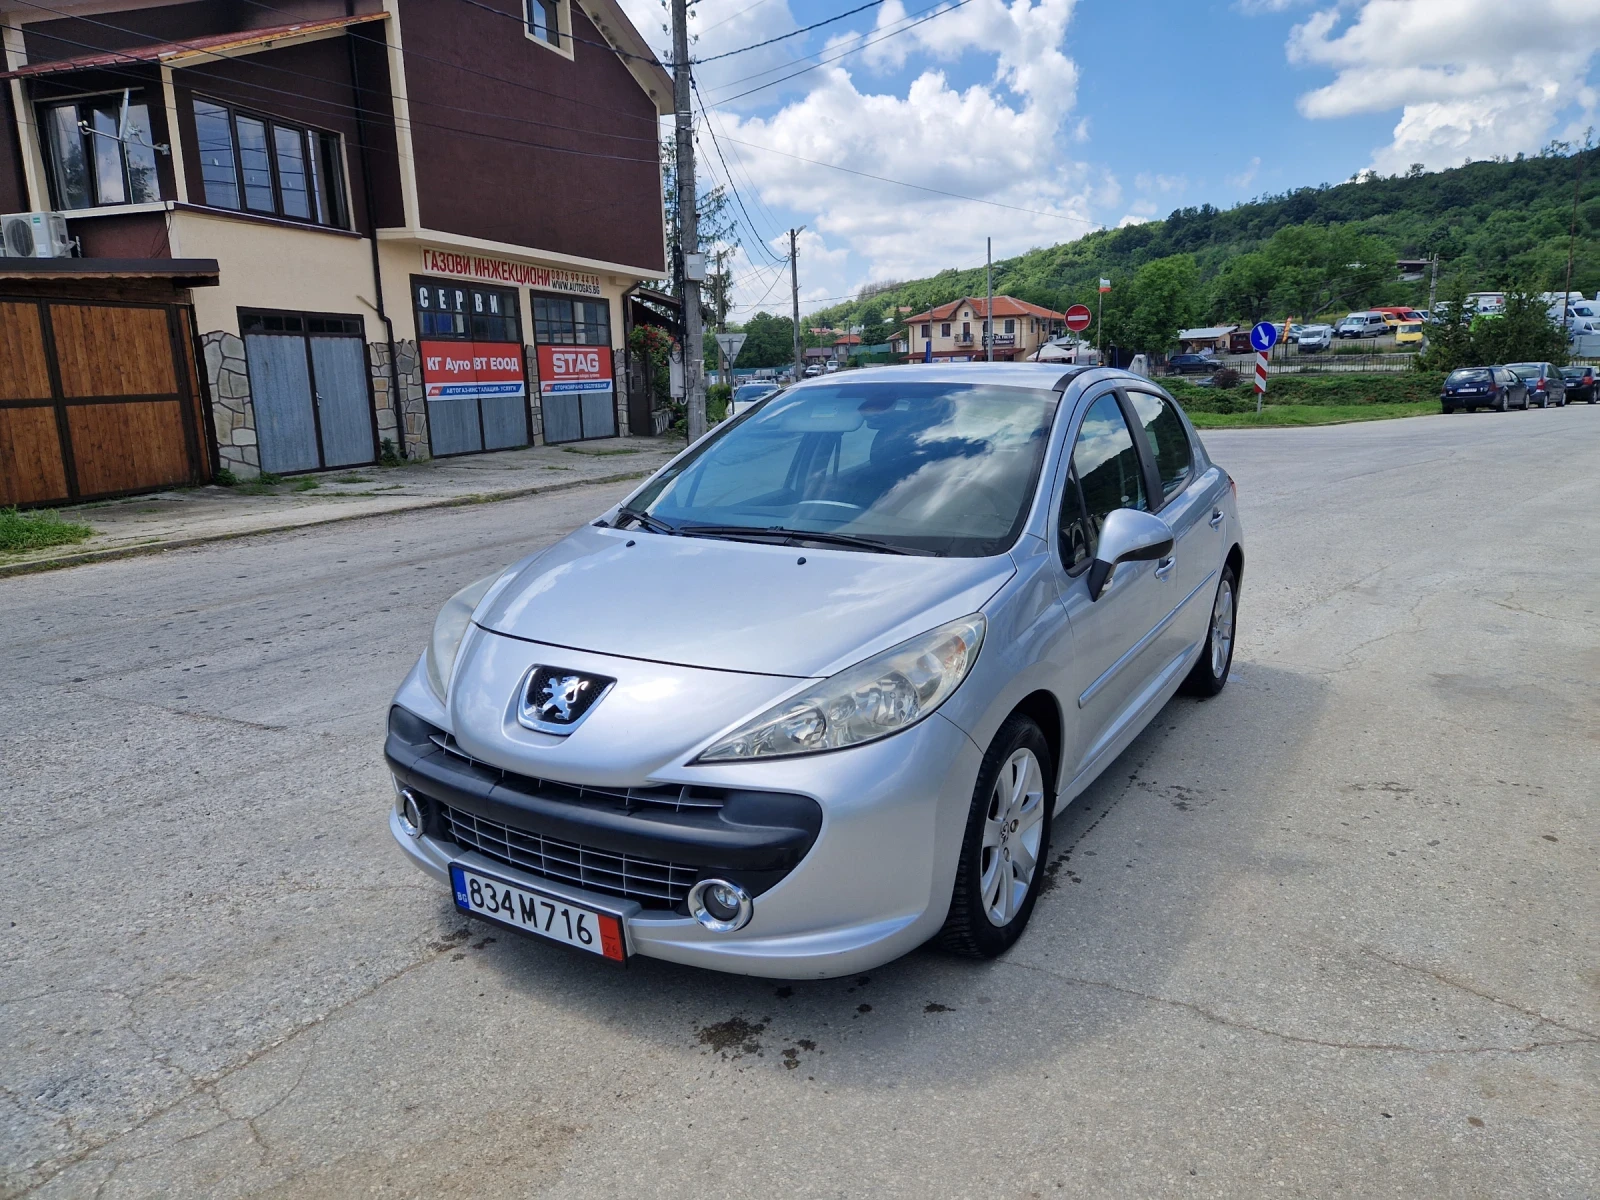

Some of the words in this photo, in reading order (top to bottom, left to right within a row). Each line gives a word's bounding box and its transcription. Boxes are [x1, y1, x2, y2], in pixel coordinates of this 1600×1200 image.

[423, 249, 471, 275] ГАЗОВИ
[474, 257, 550, 286] ИНЖЕКЦИОНИ
[551, 270, 569, 281] 0876
[551, 280, 600, 295] WWW.AUTOGAS.BG
[426, 357, 442, 370] КГ
[445, 357, 471, 373] Ауто
[473, 357, 488, 370] ВТ
[490, 357, 519, 372] ЕООД
[552, 353, 599, 373] STAG
[457, 891, 468, 903] BG
[469, 878, 593, 945] 834M716
[605, 942, 618, 955] 26
